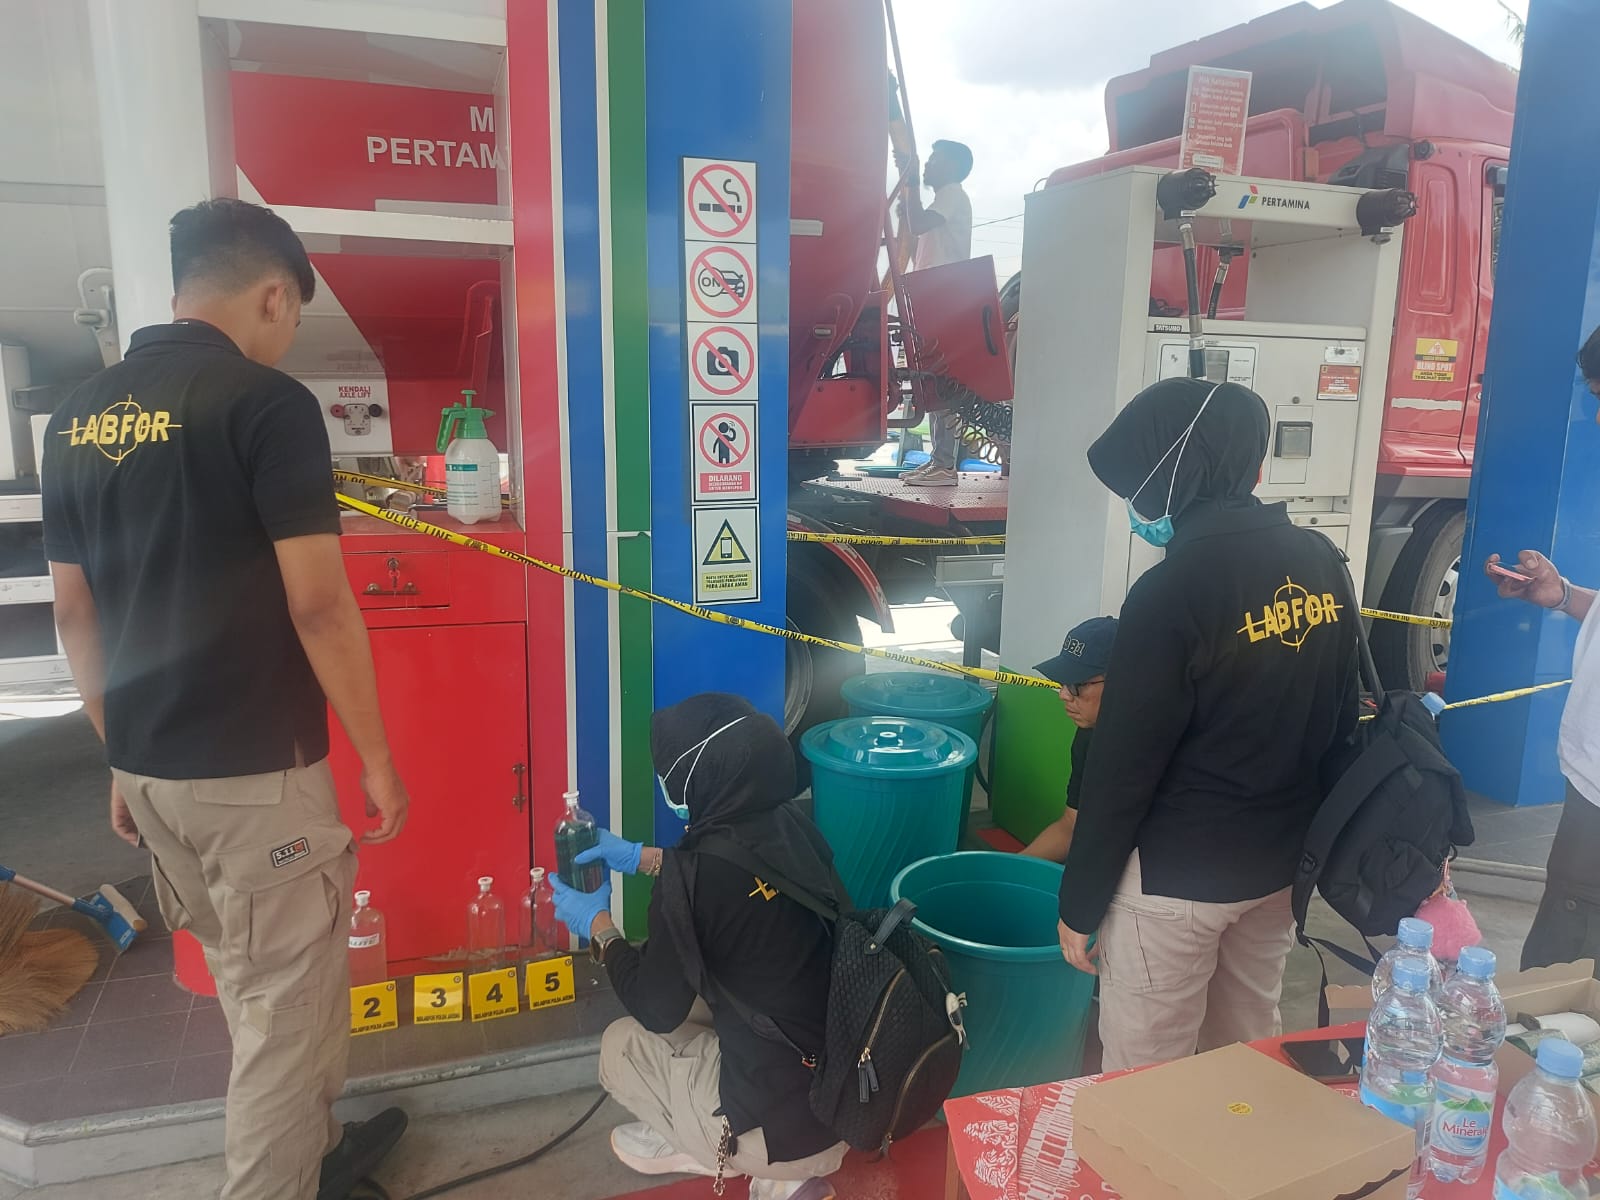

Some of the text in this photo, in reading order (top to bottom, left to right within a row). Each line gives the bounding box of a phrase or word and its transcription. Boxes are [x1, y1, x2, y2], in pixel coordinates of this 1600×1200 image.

[1261, 196, 1310, 210] PERTAMINA
[338, 385, 371, 393] KENDALI
[70, 411, 170, 446] LABFOR
[377, 508, 453, 541] POLICE LINE
[1245, 593, 1339, 643] LABFOR
[994, 671, 1008, 682] DO
[1009, 674, 1030, 687] NOT
[544, 971, 561, 992] 5
[430, 987, 447, 1008] 3
[486, 982, 504, 1003] 4
[363, 996, 381, 1019] 2
[1462, 1117, 1477, 1128] Le
